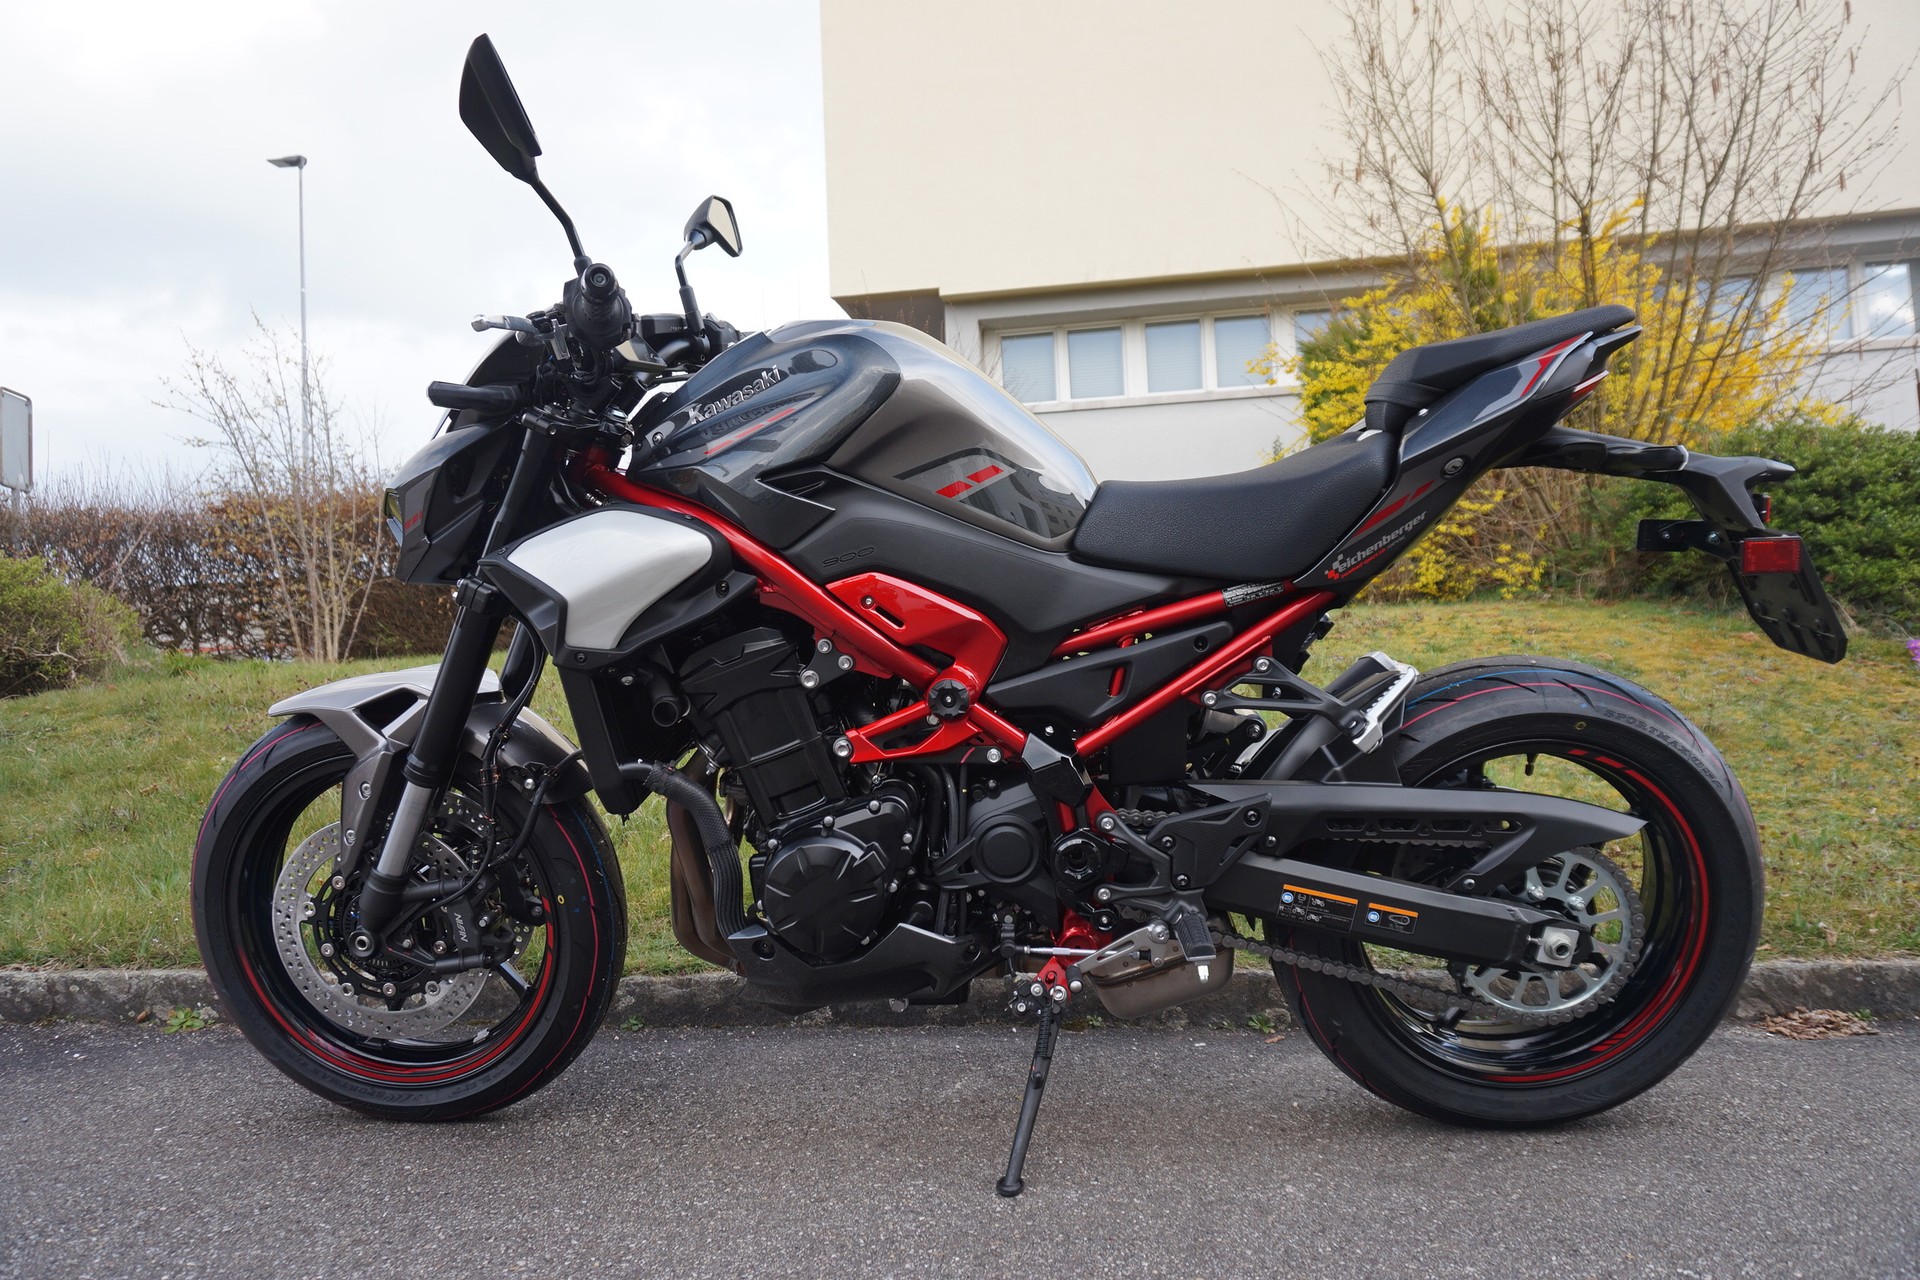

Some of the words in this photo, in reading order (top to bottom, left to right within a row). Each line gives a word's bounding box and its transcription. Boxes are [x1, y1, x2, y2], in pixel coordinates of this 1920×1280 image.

[688, 364, 781, 425] Kawasaki
[822, 546, 875, 568] 900
[1339, 511, 1427, 572] eichenberger
[1604, 709, 1692, 757] SPORTMAX
